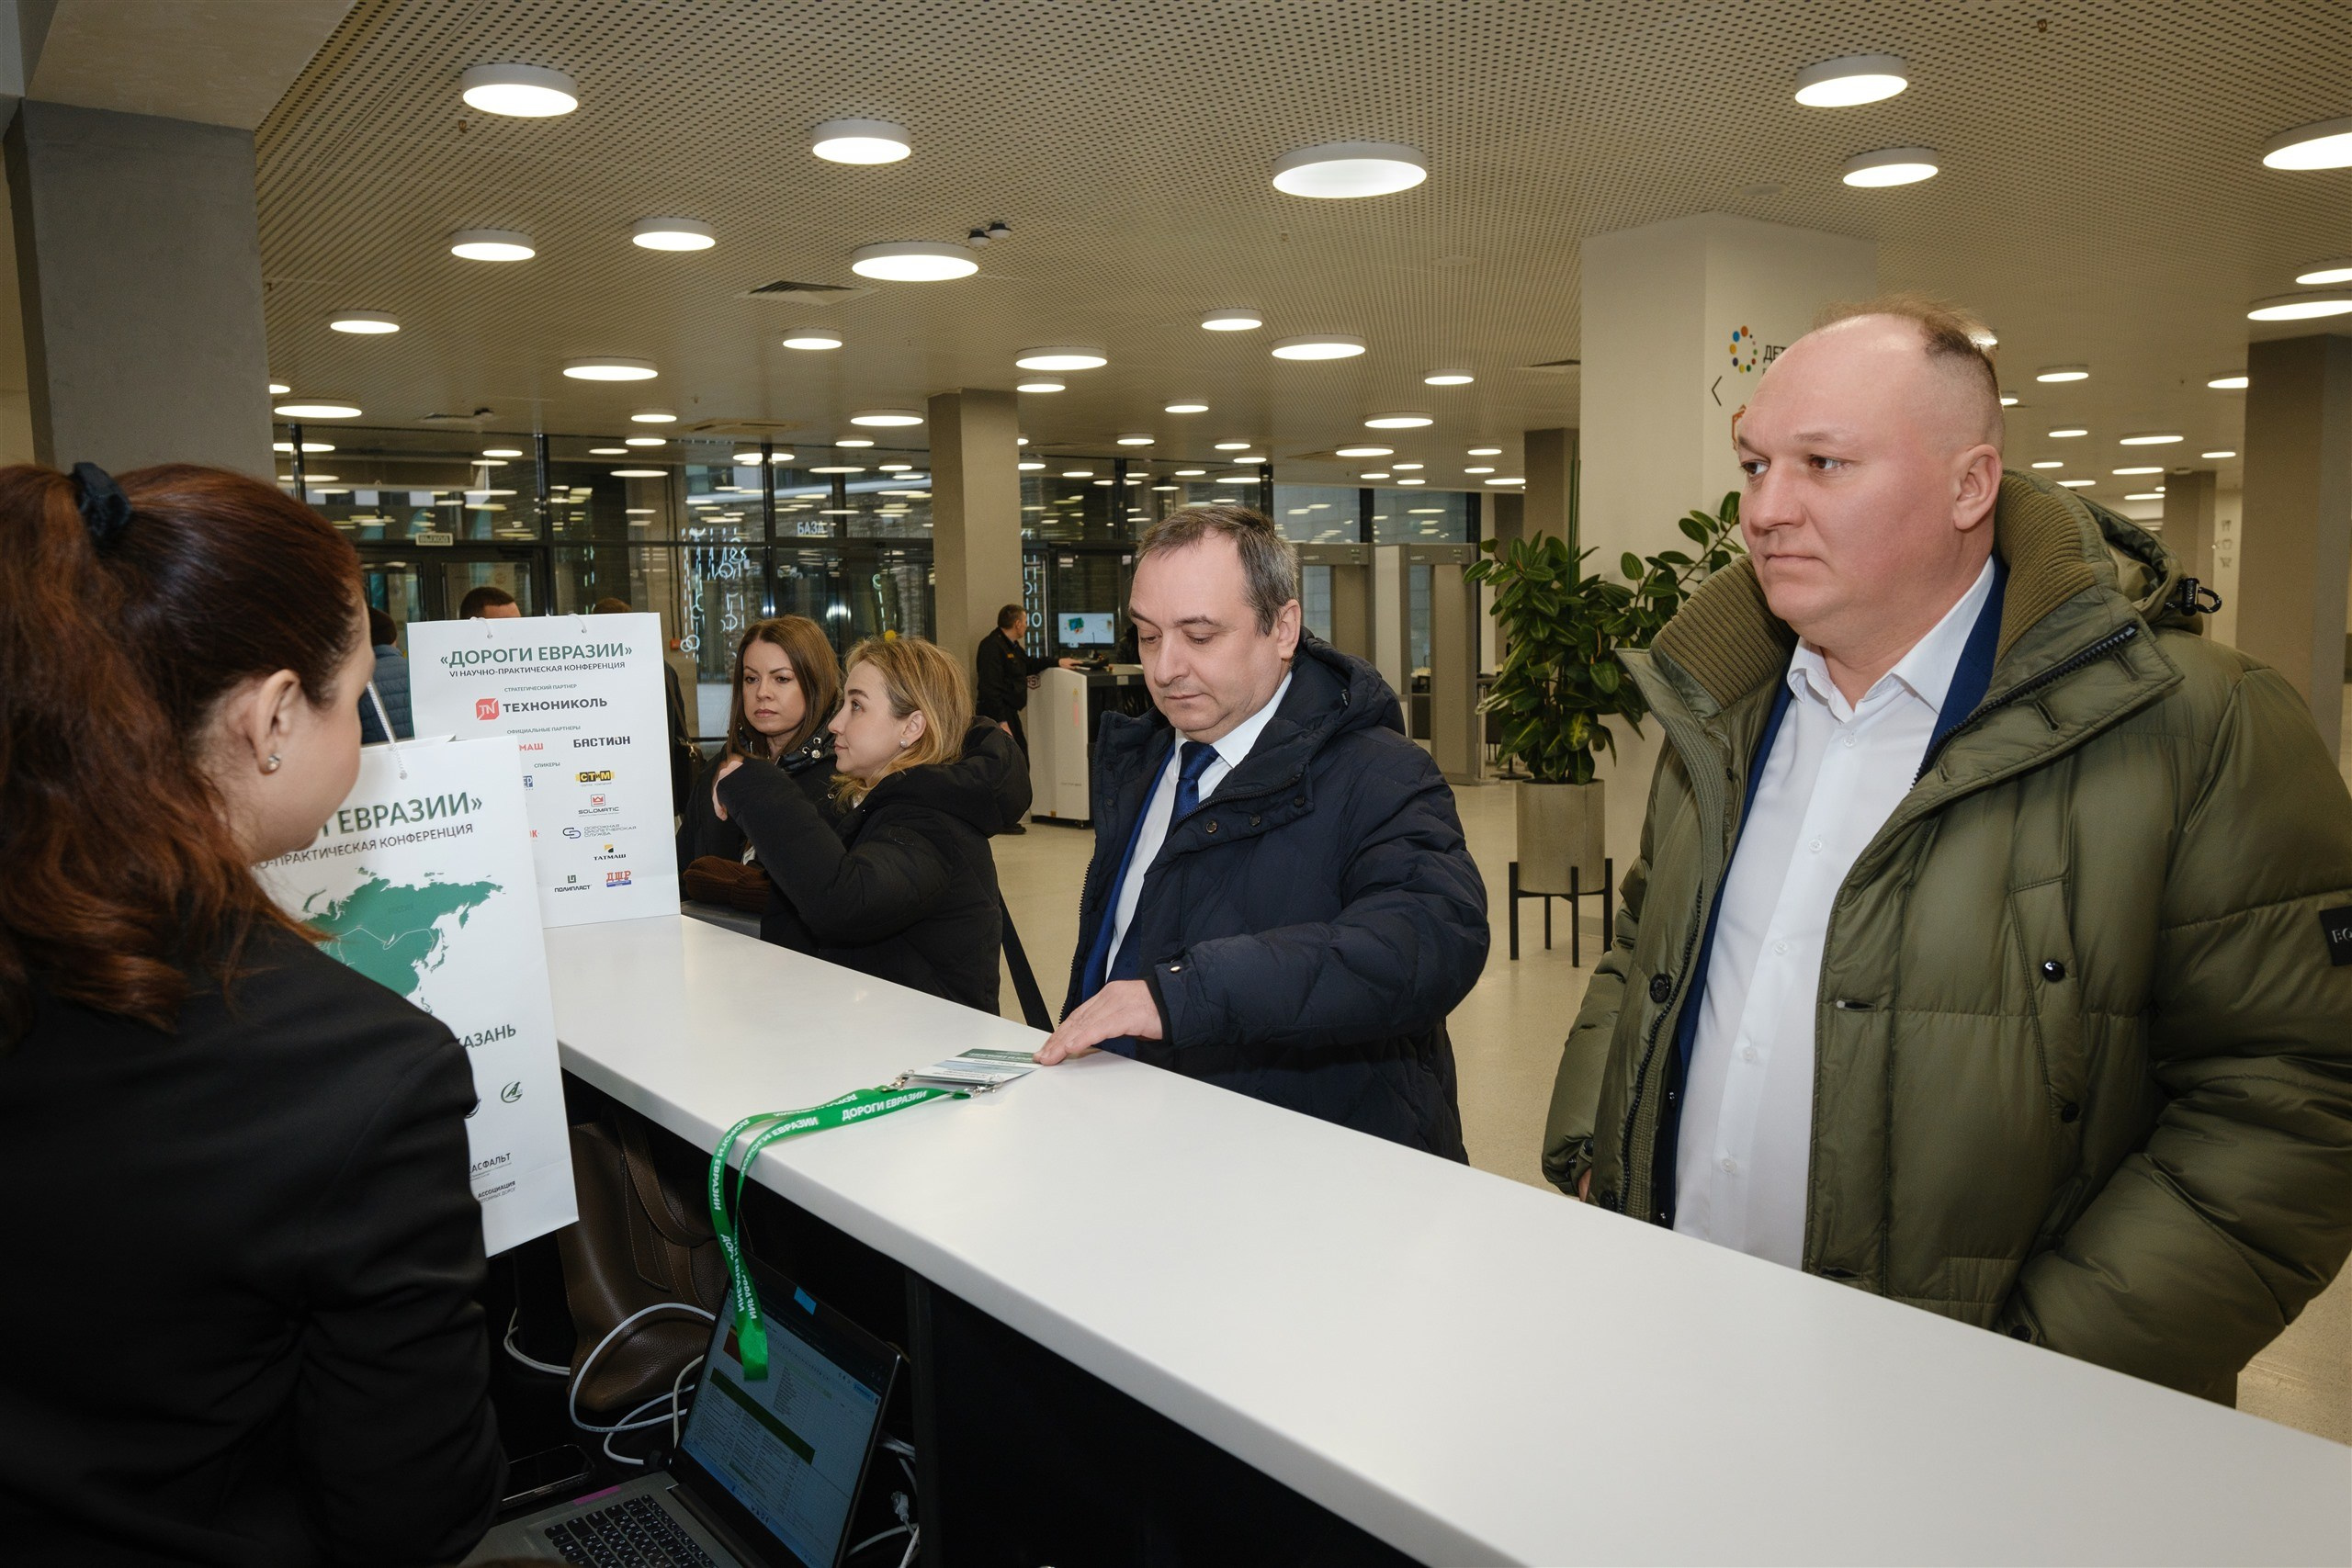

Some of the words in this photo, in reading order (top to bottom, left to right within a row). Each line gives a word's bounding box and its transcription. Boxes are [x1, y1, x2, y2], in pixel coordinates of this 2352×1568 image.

[797, 521, 825, 535] БАЗА
[440, 647, 533, 669] «ДОРОГИ
[538, 642, 632, 661] ЕВРАЗИИ»
[460, 664, 562, 677] НАУЧНО-ПРАКТИЧЕСКАЯ
[564, 661, 626, 671] КОНФЕРЕНЦИЯ
[503, 697, 608, 713] ТЕХНОНИКОЛЬ
[573, 736, 630, 748] БАСТИОН
[337, 792, 482, 835] ЕВРАЗИИ»
[578, 807, 619, 815] SOLOMATIC
[379, 823, 473, 849] КОНФЕРЕНЦИЯ
[458, 1024, 516, 1048] АЗАНЬ
[842, 1101, 885, 1121] ДОРОГИ
[886, 1090, 927, 1109] ЕВРАЗИИ
[772, 1117, 819, 1136] ЕВРАЗИИ
[717, 1119, 750, 1157] ДОРОГИ
[478, 1180, 515, 1198] АССОЦИАЦИЯ
[712, 1159, 721, 1211] ЕВРАЗИИ
